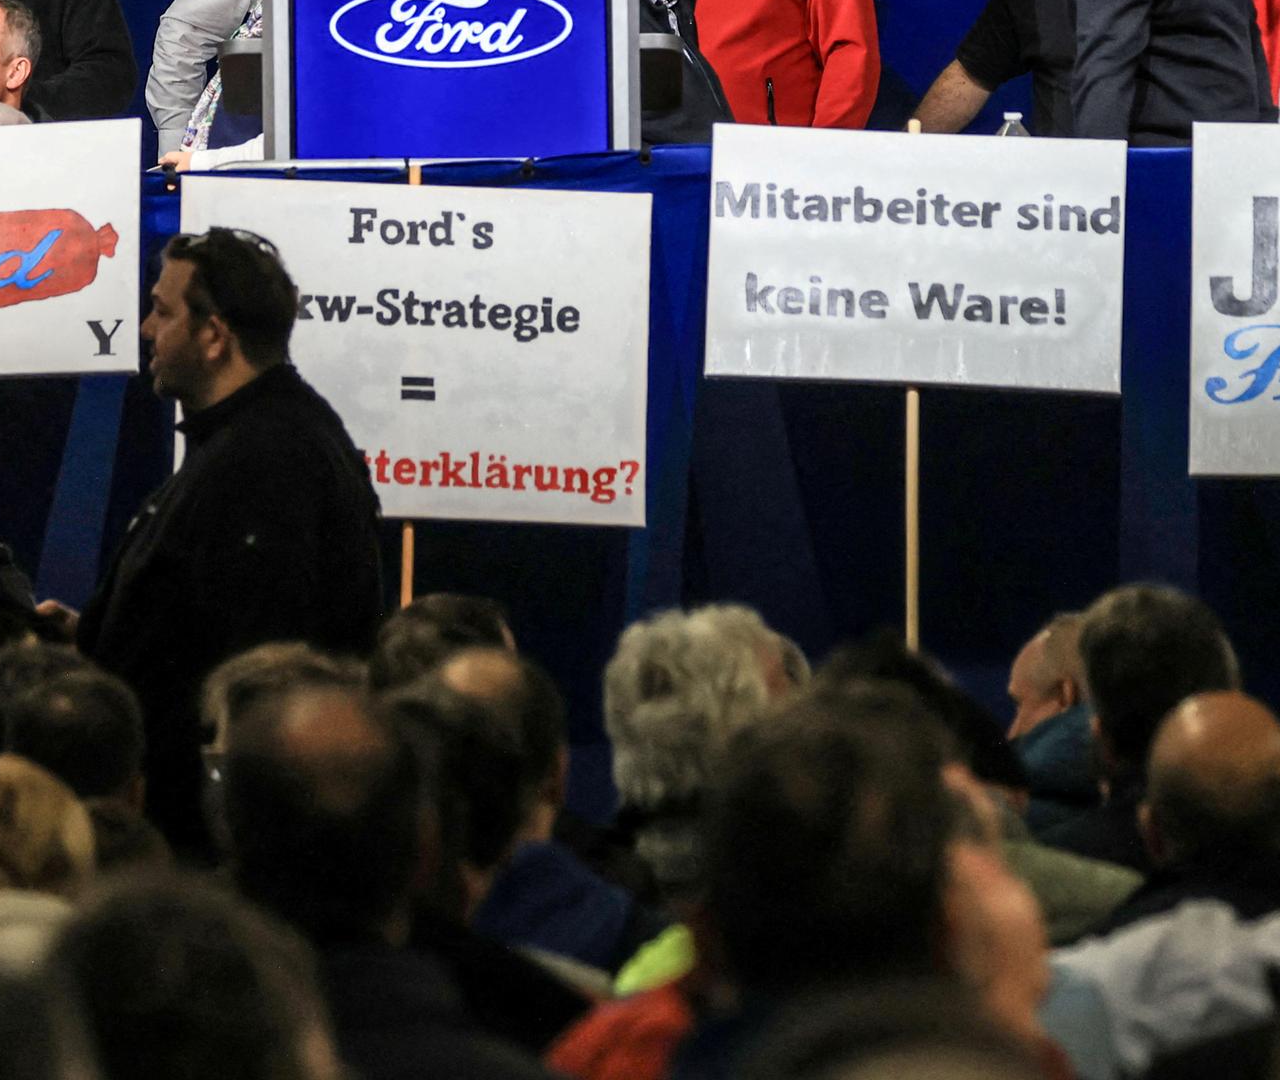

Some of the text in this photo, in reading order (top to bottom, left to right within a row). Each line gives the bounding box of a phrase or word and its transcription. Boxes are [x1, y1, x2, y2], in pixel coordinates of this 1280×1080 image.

[714, 181, 1120, 234] Mitarbeiter sind
[298, 289, 581, 342] kw-Strategie
[745, 272, 1066, 325] keine Ware!
[86, 320, 123, 356] Y
[363, 449, 641, 503] terklärung?
